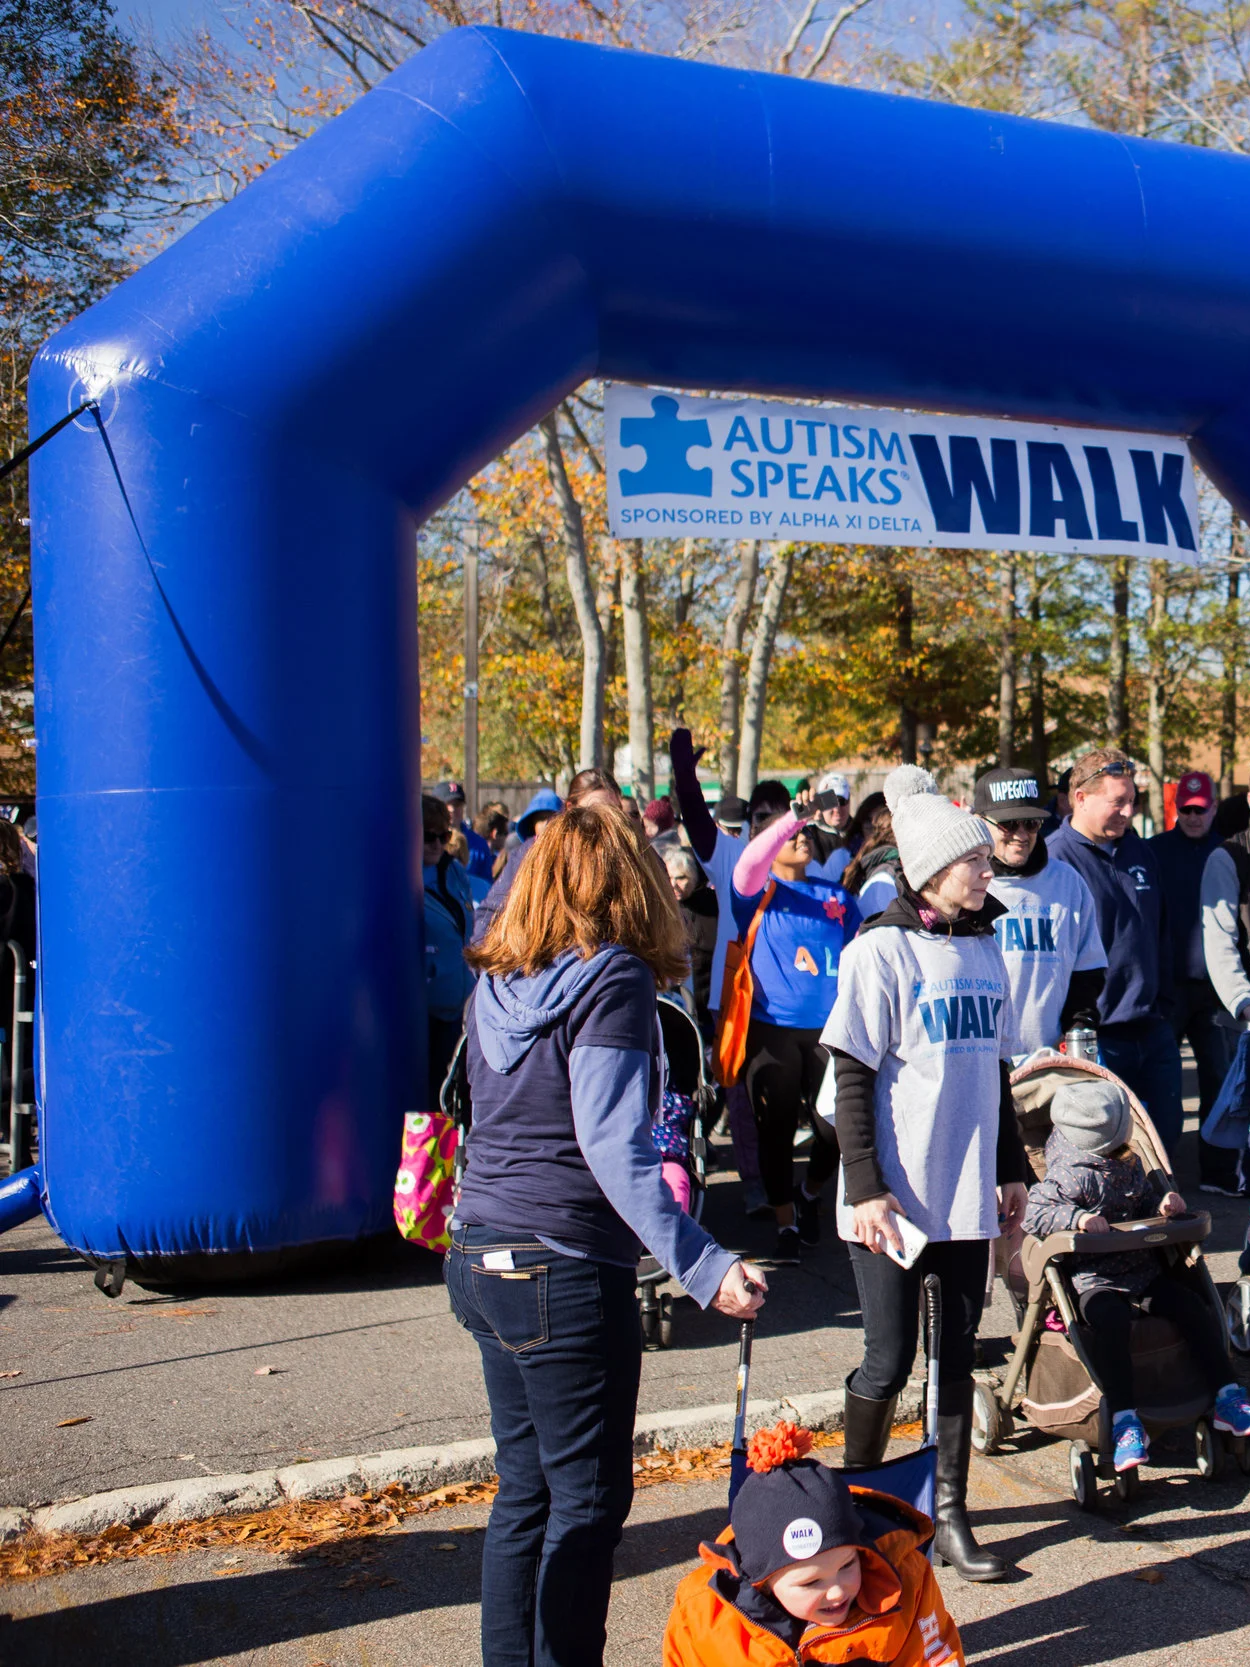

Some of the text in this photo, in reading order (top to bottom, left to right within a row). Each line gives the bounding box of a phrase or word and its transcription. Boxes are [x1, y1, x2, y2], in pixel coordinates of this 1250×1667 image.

[723, 415, 908, 465] AUTISM
[730, 459, 904, 506] SPEAKS
[909, 433, 1197, 552] WALK
[620, 508, 922, 533] SPONSORED BY ALPHA XI DELTA
[930, 978, 973, 993] AUTISM
[790, 1528, 814, 1540] WALK
